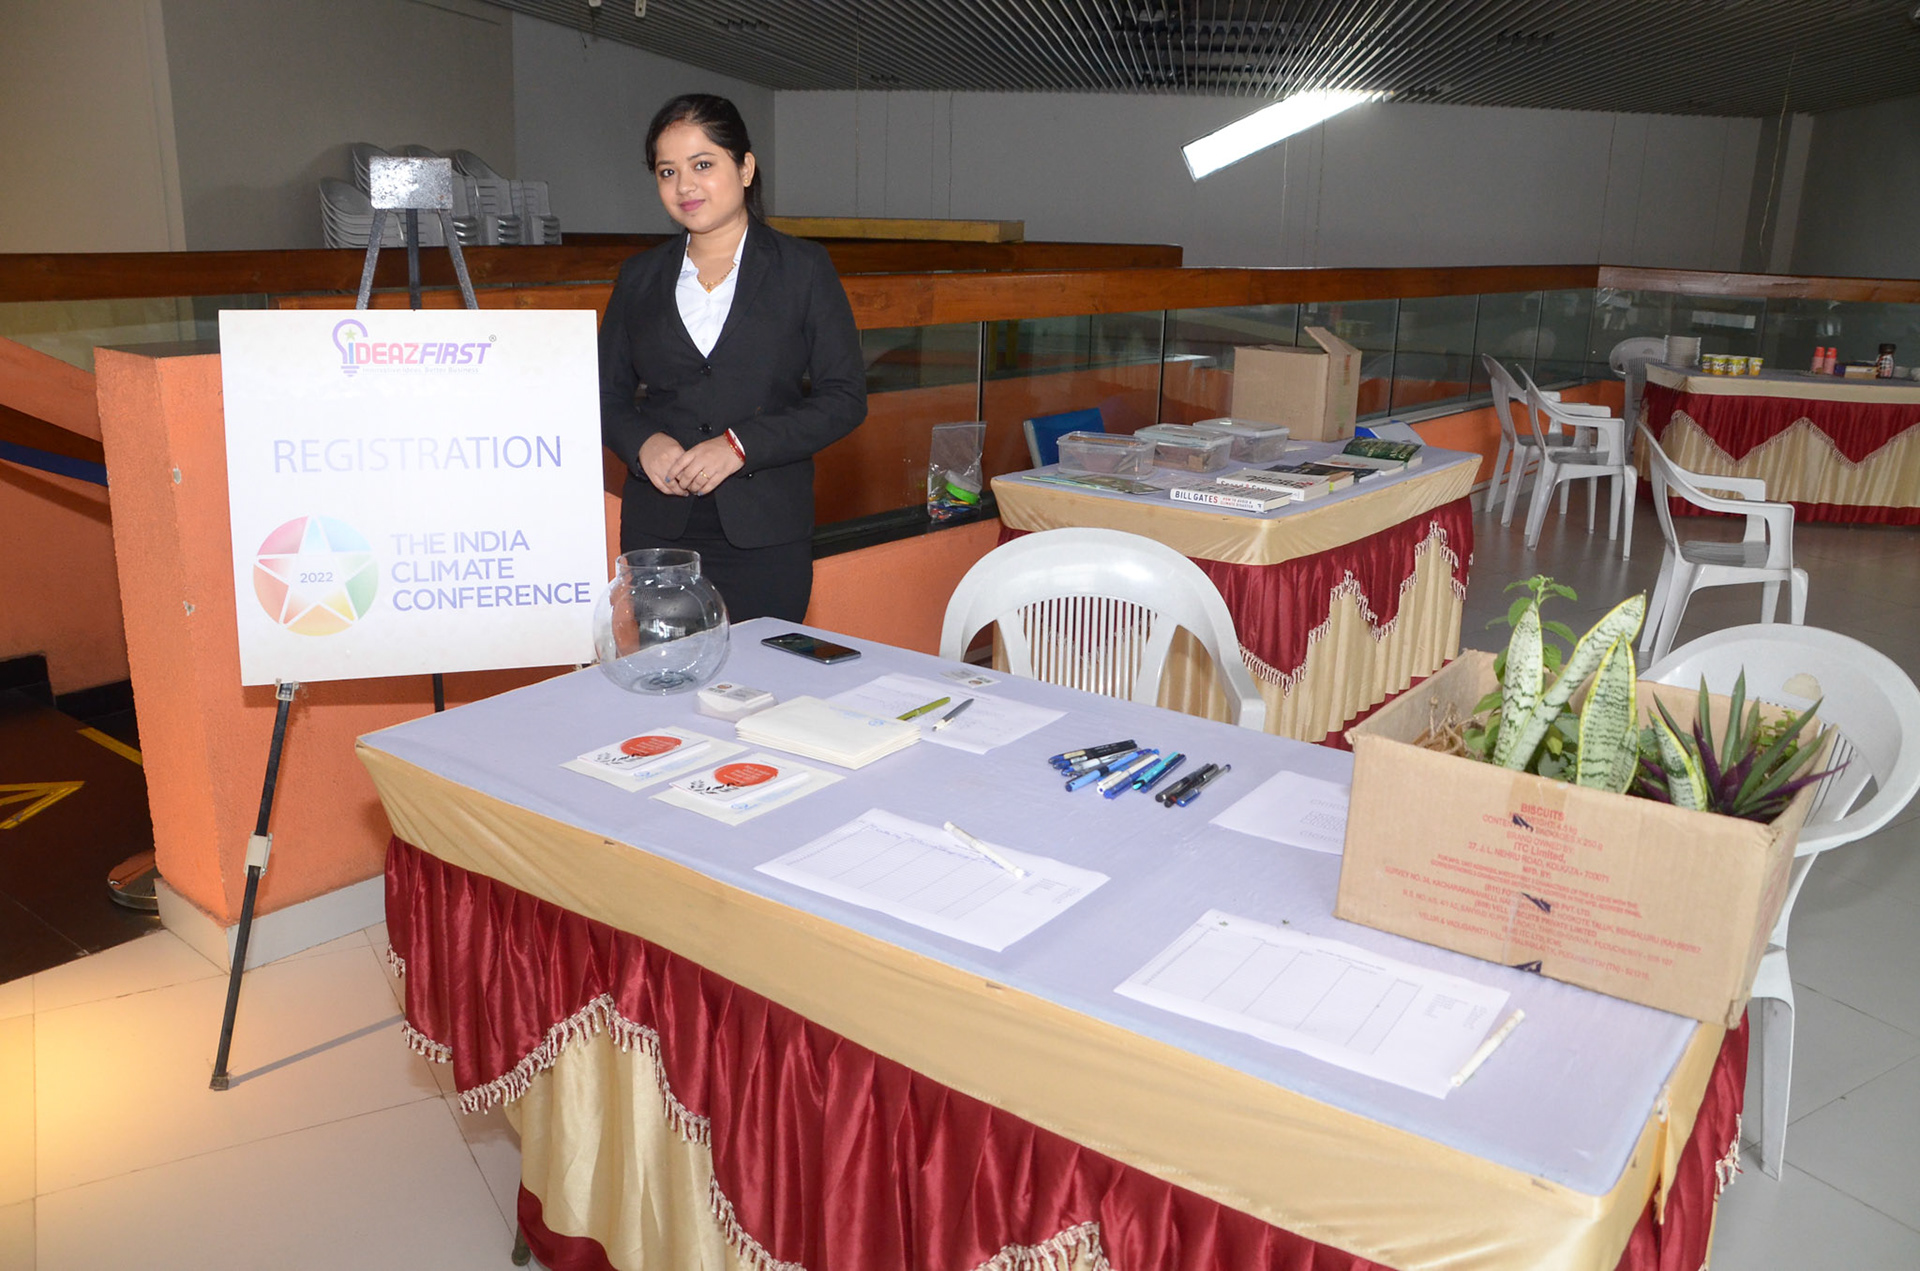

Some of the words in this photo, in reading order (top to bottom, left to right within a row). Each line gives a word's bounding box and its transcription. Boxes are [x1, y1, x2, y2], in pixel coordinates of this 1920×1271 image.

[273, 435, 562, 474] REGISTRATION
[1174, 490, 1192, 501] BILL
[1193, 492, 1218, 504] GATES
[390, 532, 446, 556] THE
[454, 530, 530, 554] INDIA
[300, 571, 334, 583] 2022
[391, 558, 514, 583] CLIMATE
[392, 582, 591, 612] CONFERENCE
[1520, 803, 1564, 820] BISCUITS
[1494, 848, 1519, 860] NEHRU
[1514, 841, 1528, 852] ITC
